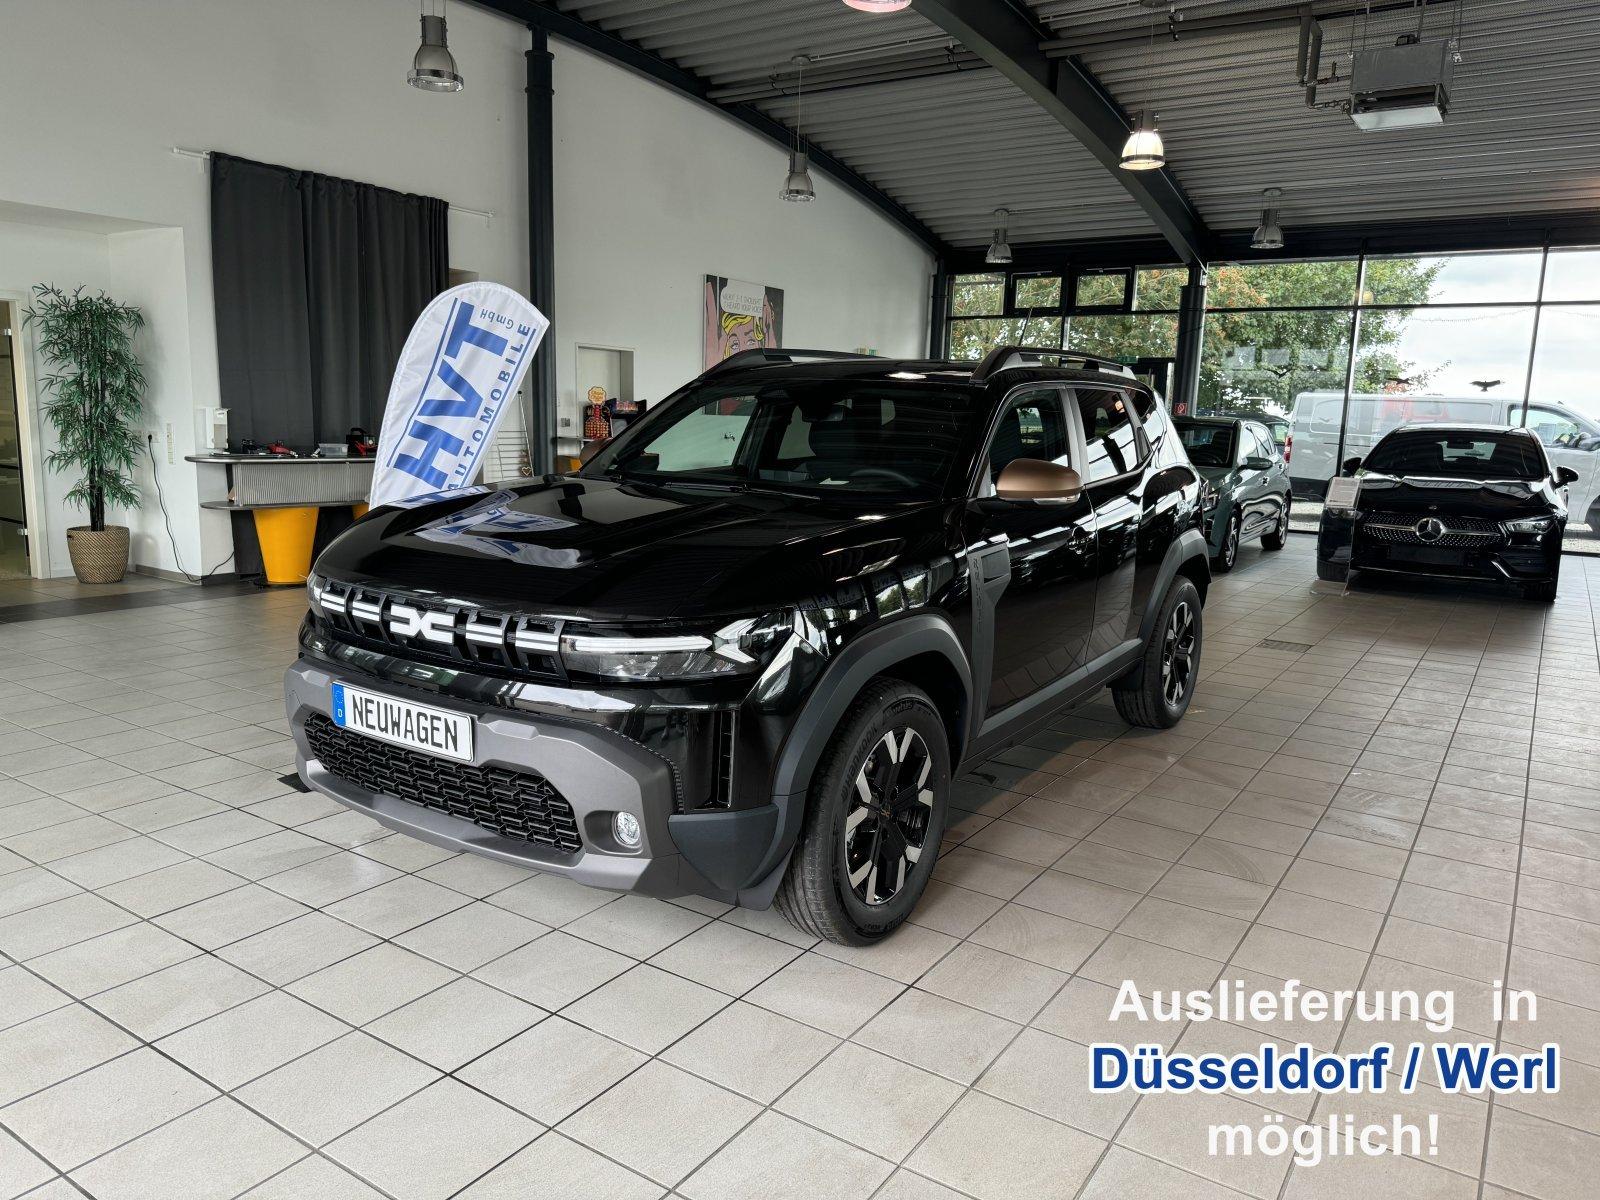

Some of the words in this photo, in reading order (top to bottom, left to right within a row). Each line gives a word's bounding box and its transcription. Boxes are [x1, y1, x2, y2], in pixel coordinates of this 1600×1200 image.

[479, 308, 514, 329] GmbH
[393, 301, 509, 490] HVT
[352, 694, 458, 752] NEUWAGEN
